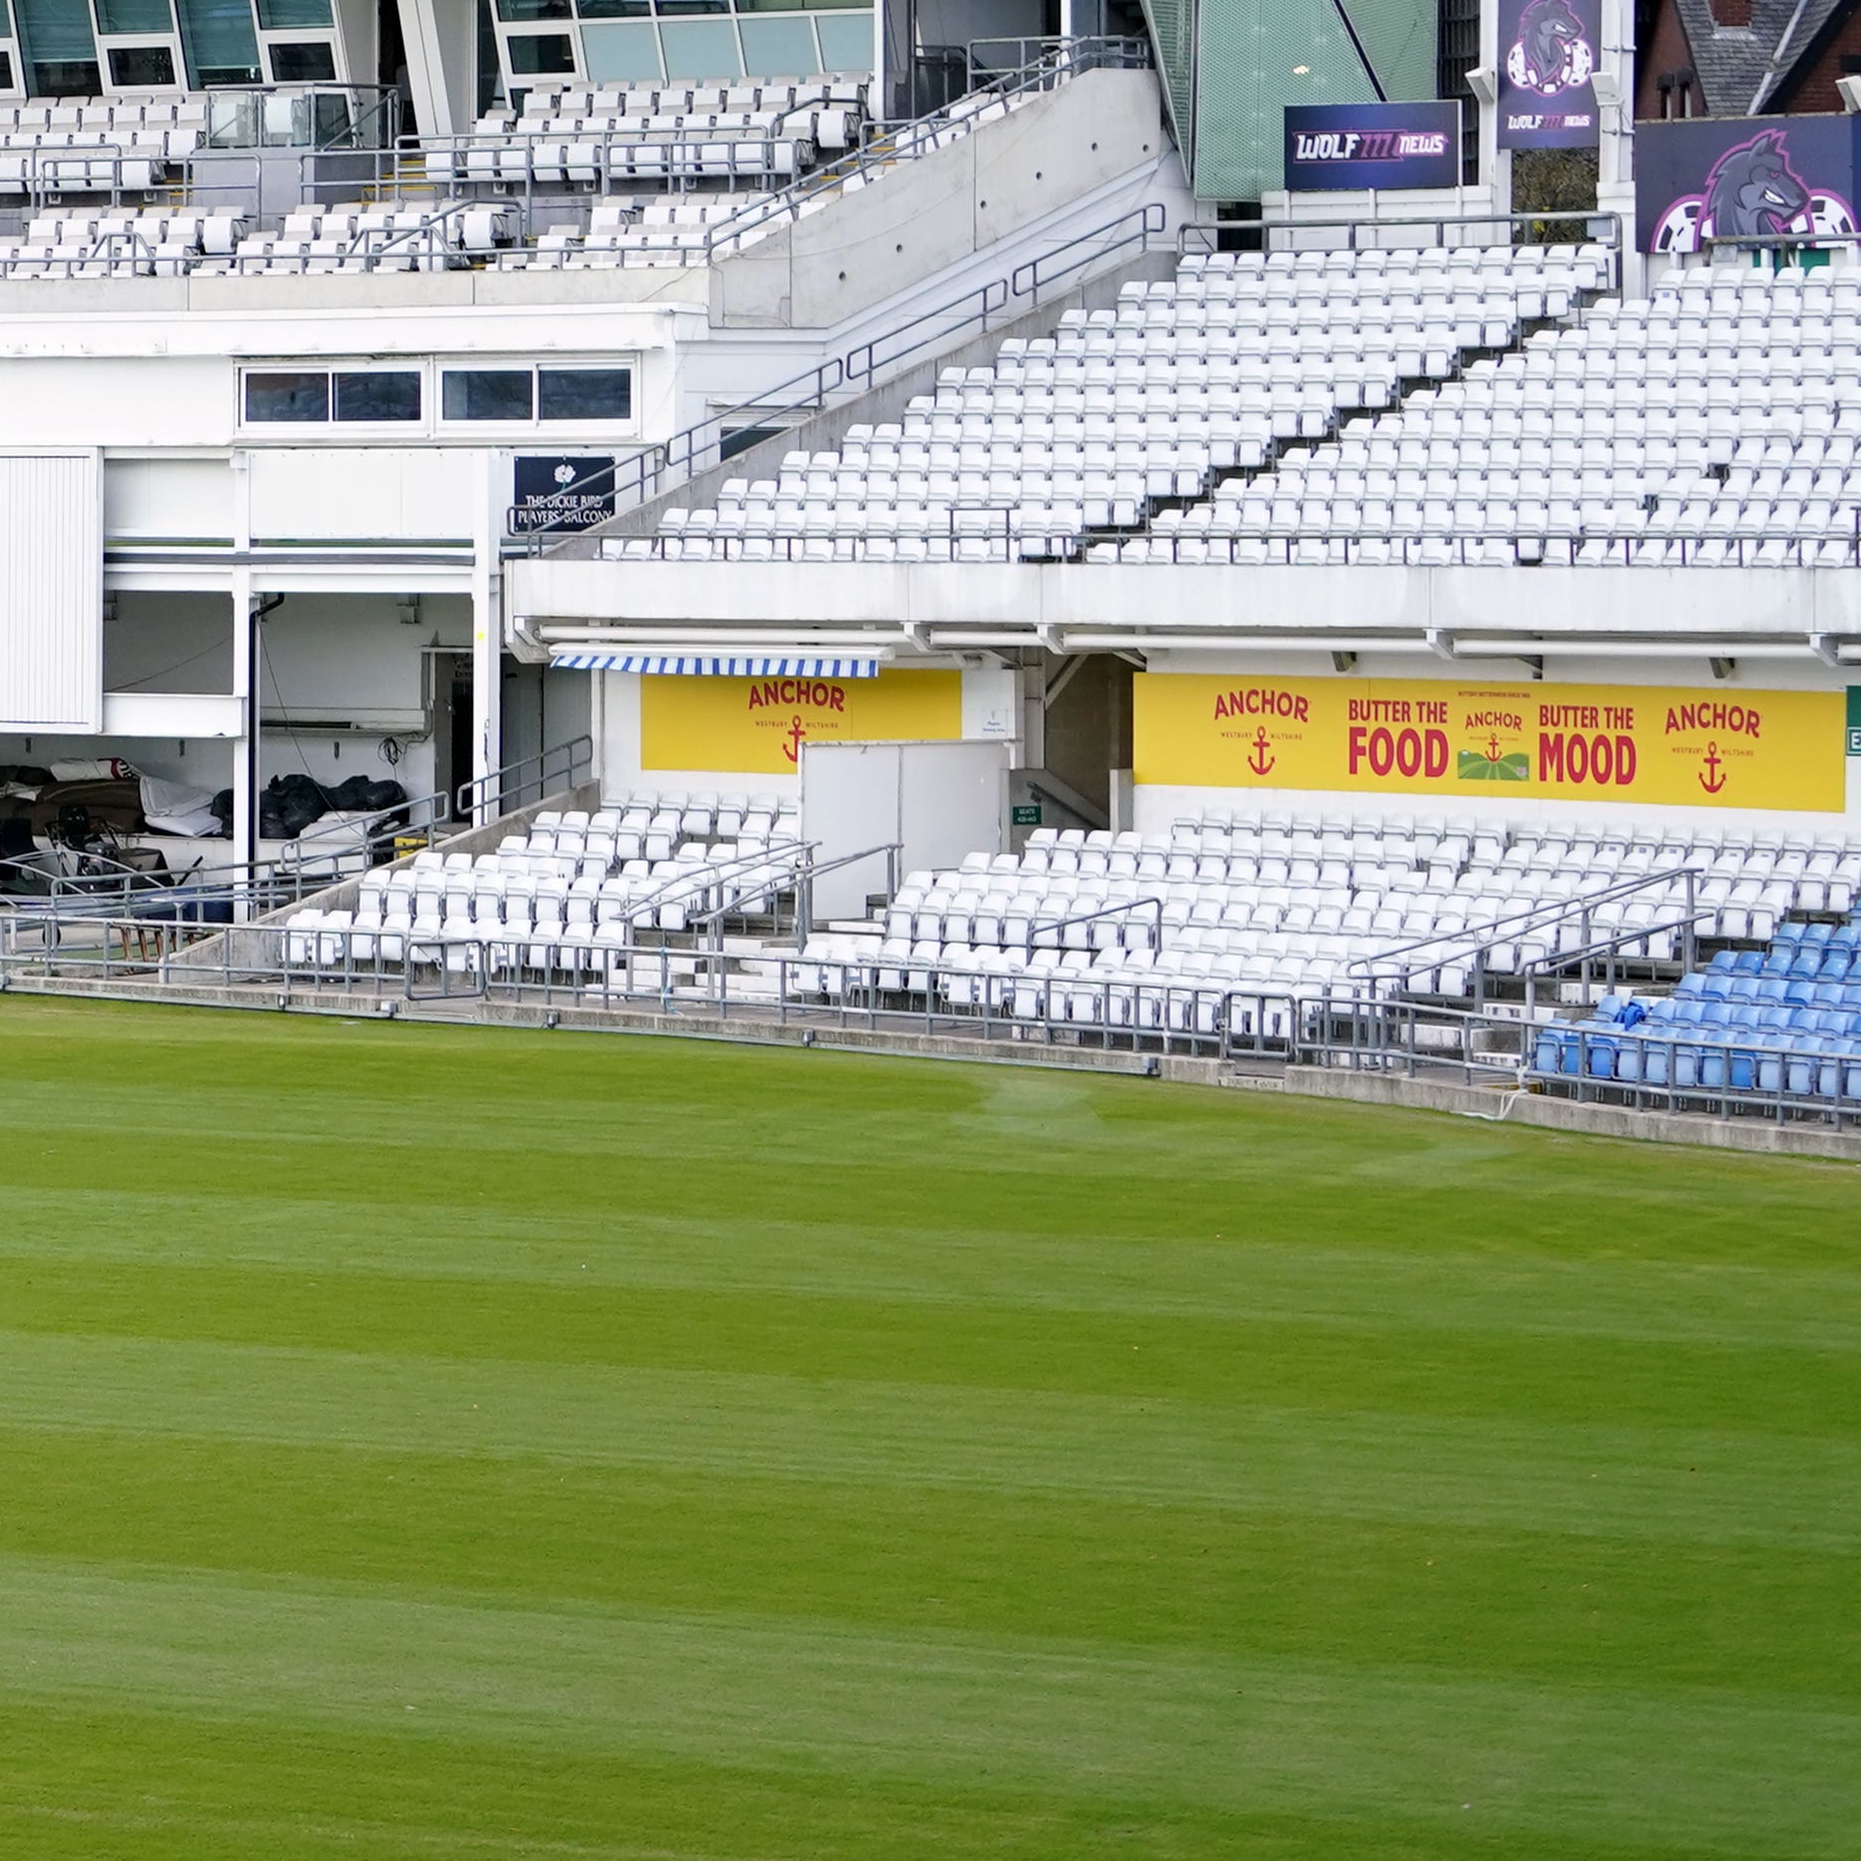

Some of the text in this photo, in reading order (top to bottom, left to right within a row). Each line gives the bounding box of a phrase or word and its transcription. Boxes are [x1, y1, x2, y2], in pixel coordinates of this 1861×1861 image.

[1399, 135, 1444, 154] NEWS
[525, 495, 545, 509] THE
[564, 510, 612, 524] BALCONY
[748, 680, 845, 712] ANCHOR
[1214, 689, 1309, 723] ANCHOR
[1349, 699, 1447, 724] BUTTER THE
[1465, 711, 1522, 731] ANCHOR
[1539, 705, 1633, 729] BUTTER THE
[1665, 702, 1760, 739] ANCHOR
[1349, 726, 1449, 777] FOOD
[1539, 732, 1636, 785] MOOD
